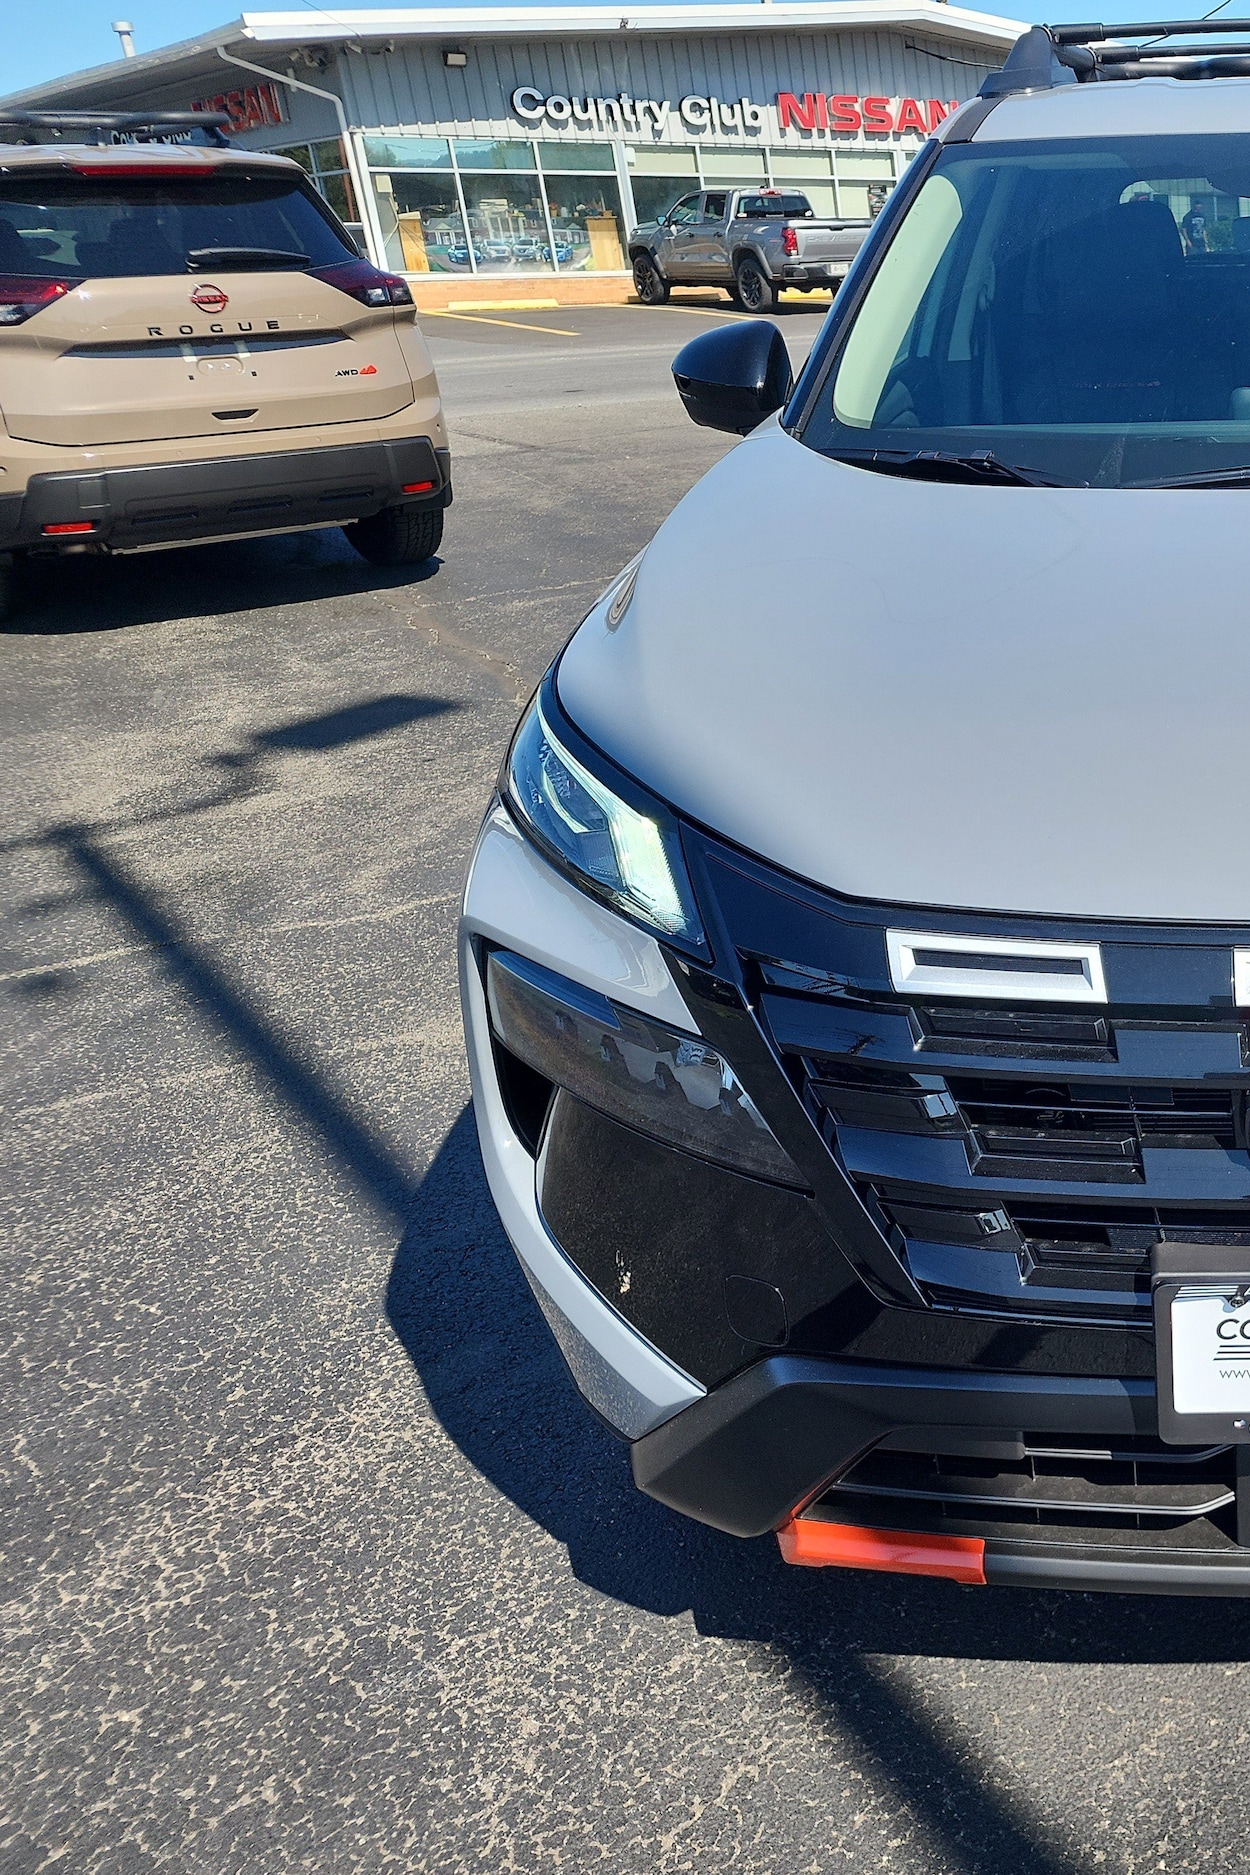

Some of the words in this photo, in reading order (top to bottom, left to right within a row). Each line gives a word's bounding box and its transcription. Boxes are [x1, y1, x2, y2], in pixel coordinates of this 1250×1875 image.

[191, 83, 283, 134] SSAN
[512, 86, 671, 130] Country
[681, 94, 763, 128] Club
[777, 92, 960, 133] NISSAN
[146, 320, 280, 337] ROGUE
[335, 368, 359, 377] AWD
